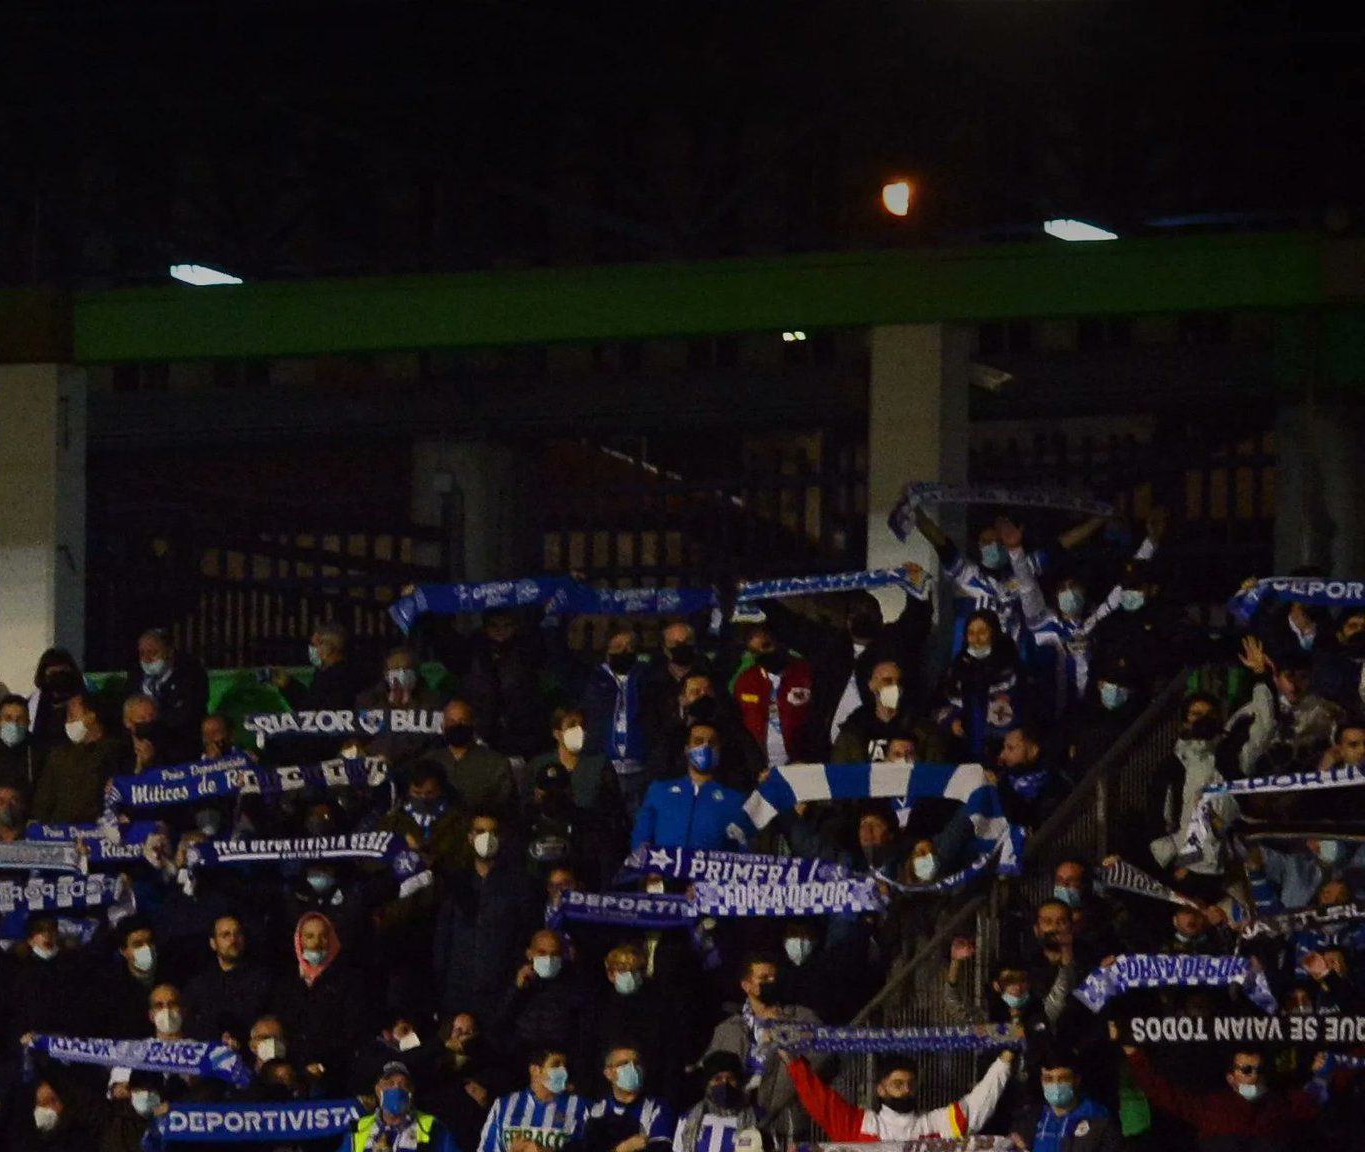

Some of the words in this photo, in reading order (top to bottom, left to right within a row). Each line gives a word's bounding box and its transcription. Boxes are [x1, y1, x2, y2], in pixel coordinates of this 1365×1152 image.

[569, 891, 683, 914] DEPORTI
[1131, 1015, 1204, 1043] TODOS
[1210, 1015, 1282, 1044] VAIAN
[1287, 1015, 1318, 1044] SE
[169, 1105, 360, 1134] DEPORTIVISTA
